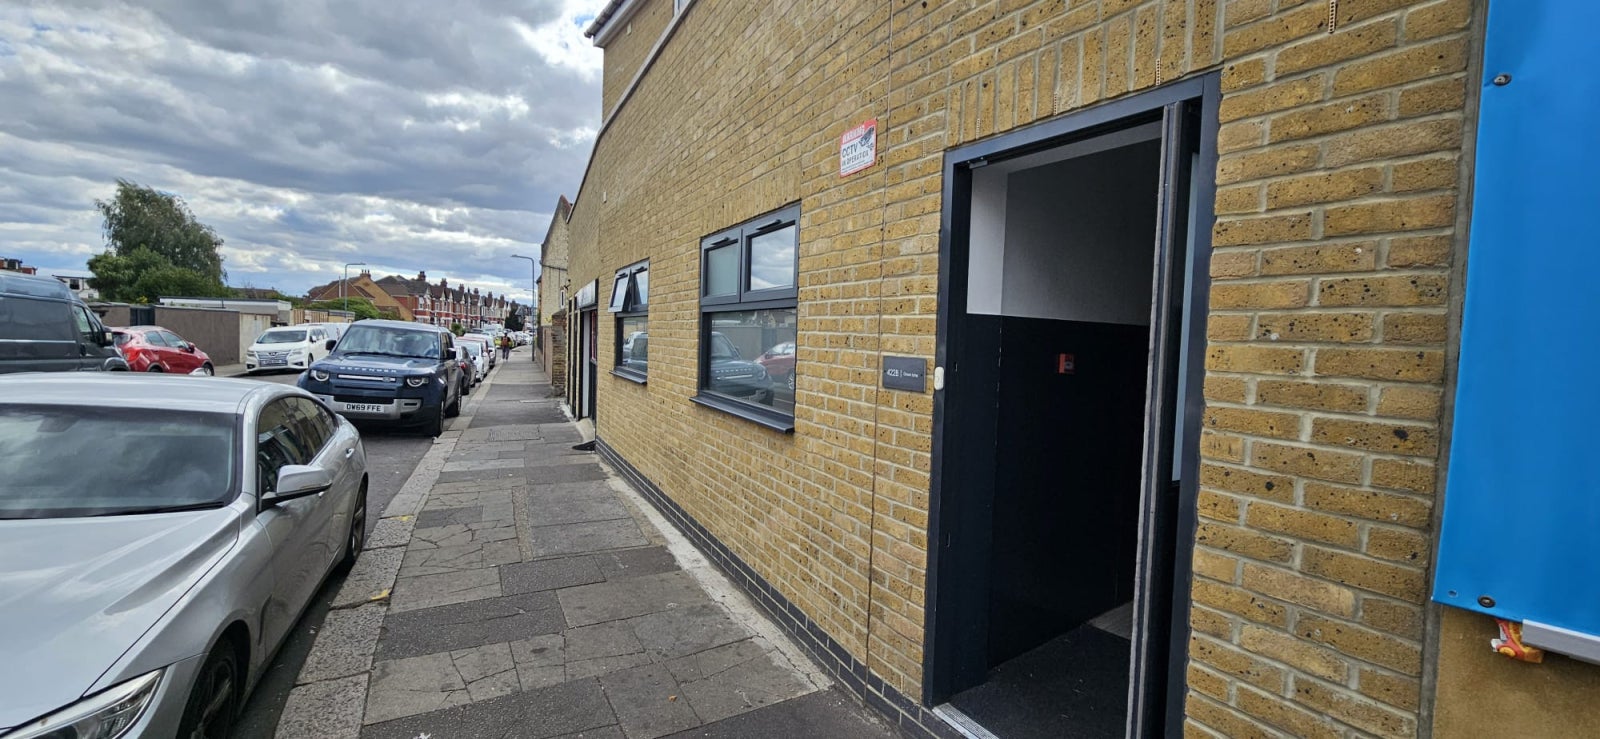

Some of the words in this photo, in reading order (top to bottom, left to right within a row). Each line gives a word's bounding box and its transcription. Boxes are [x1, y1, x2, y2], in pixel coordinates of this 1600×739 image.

[842, 143, 858, 158] CCTV
[346, 403, 366, 411] DW69
[367, 404, 382, 412] FFE
